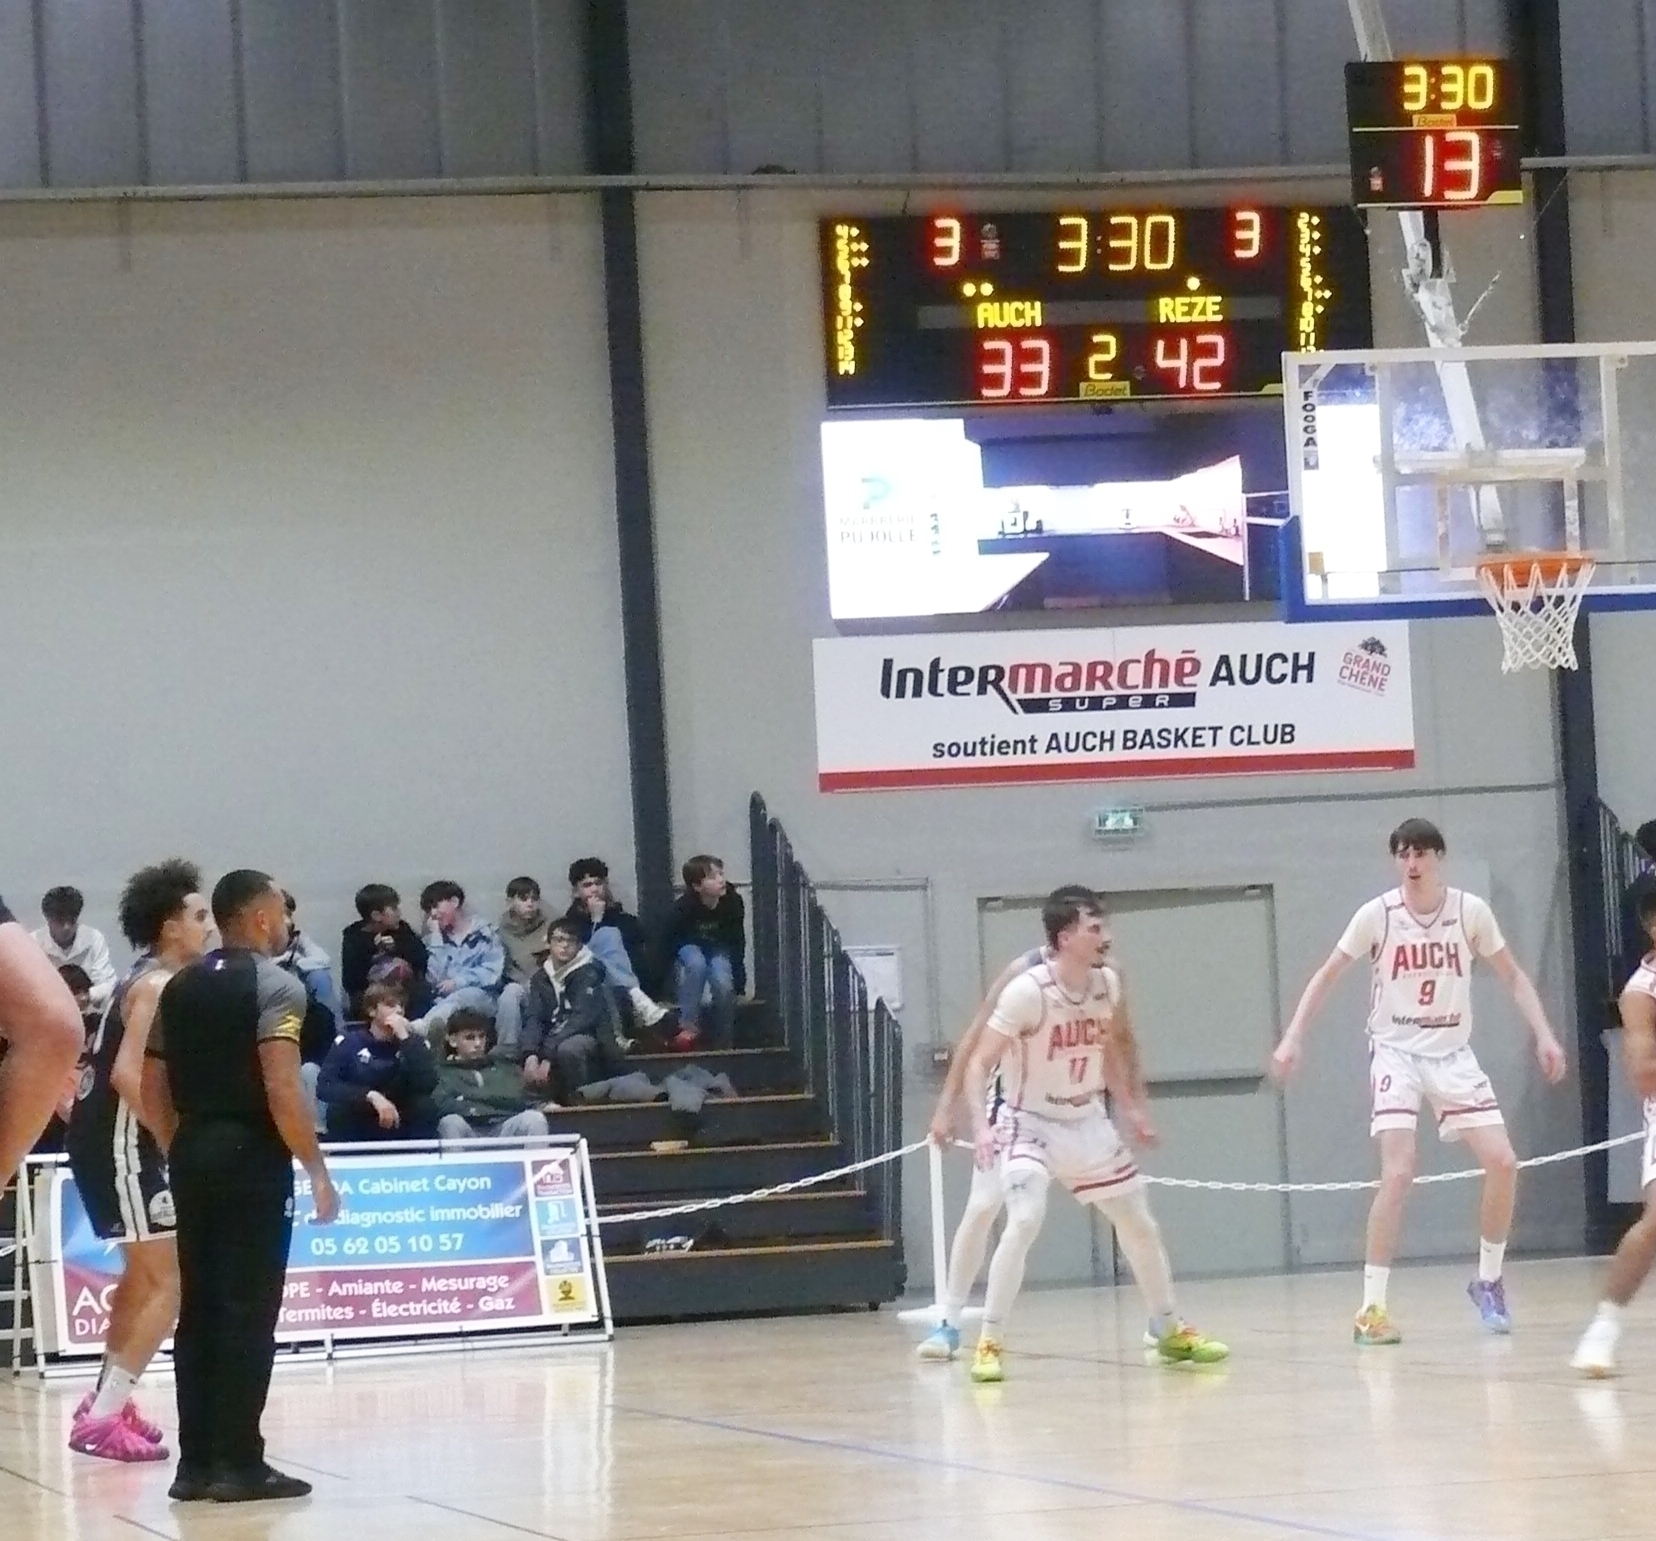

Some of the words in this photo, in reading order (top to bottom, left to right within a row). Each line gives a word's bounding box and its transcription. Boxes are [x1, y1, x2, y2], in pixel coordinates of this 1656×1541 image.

[1403, 64, 1495, 111] 3:30
[1424, 131, 1480, 200] 13
[933, 218, 960, 266] 3
[1058, 215, 1175, 272] 3:30
[1234, 211, 1260, 258] 3
[977, 301, 1042, 328] AUCH
[1158, 296, 1223, 323] REZE
[981, 339, 1050, 397] 33
[1088, 334, 1116, 380] 2
[1156, 334, 1225, 390] 42
[1084, 383, 1127, 397] Bodet
[1209, 651, 1316, 687] AUCH
[1342, 651, 1391, 677] GRAND
[932, 733, 1038, 759] soutient
[1045, 730, 1115, 754] AUCH
[1121, 726, 1224, 751] BASKET
[1229, 723, 1296, 747] CLUB
[1391, 942, 1463, 981] AUCH
[1418, 979, 1436, 1006] 9
[362, 1175, 430, 1195] Cabinet
[434, 1174, 492, 1198] Cayon
[430, 1202, 523, 1223] immobilier
[311, 1236, 338, 1256] 05
[343, 1235, 369, 1255] 62
[374, 1234, 401, 1254] 05
[407, 1233, 433, 1253] 10
[439, 1232, 465, 1252] 57
[328, 1278, 404, 1297] Amiante
[421, 1274, 509, 1297] Mesurage
[371, 1297, 462, 1318] Électricité
[478, 1295, 515, 1312] Gaz
